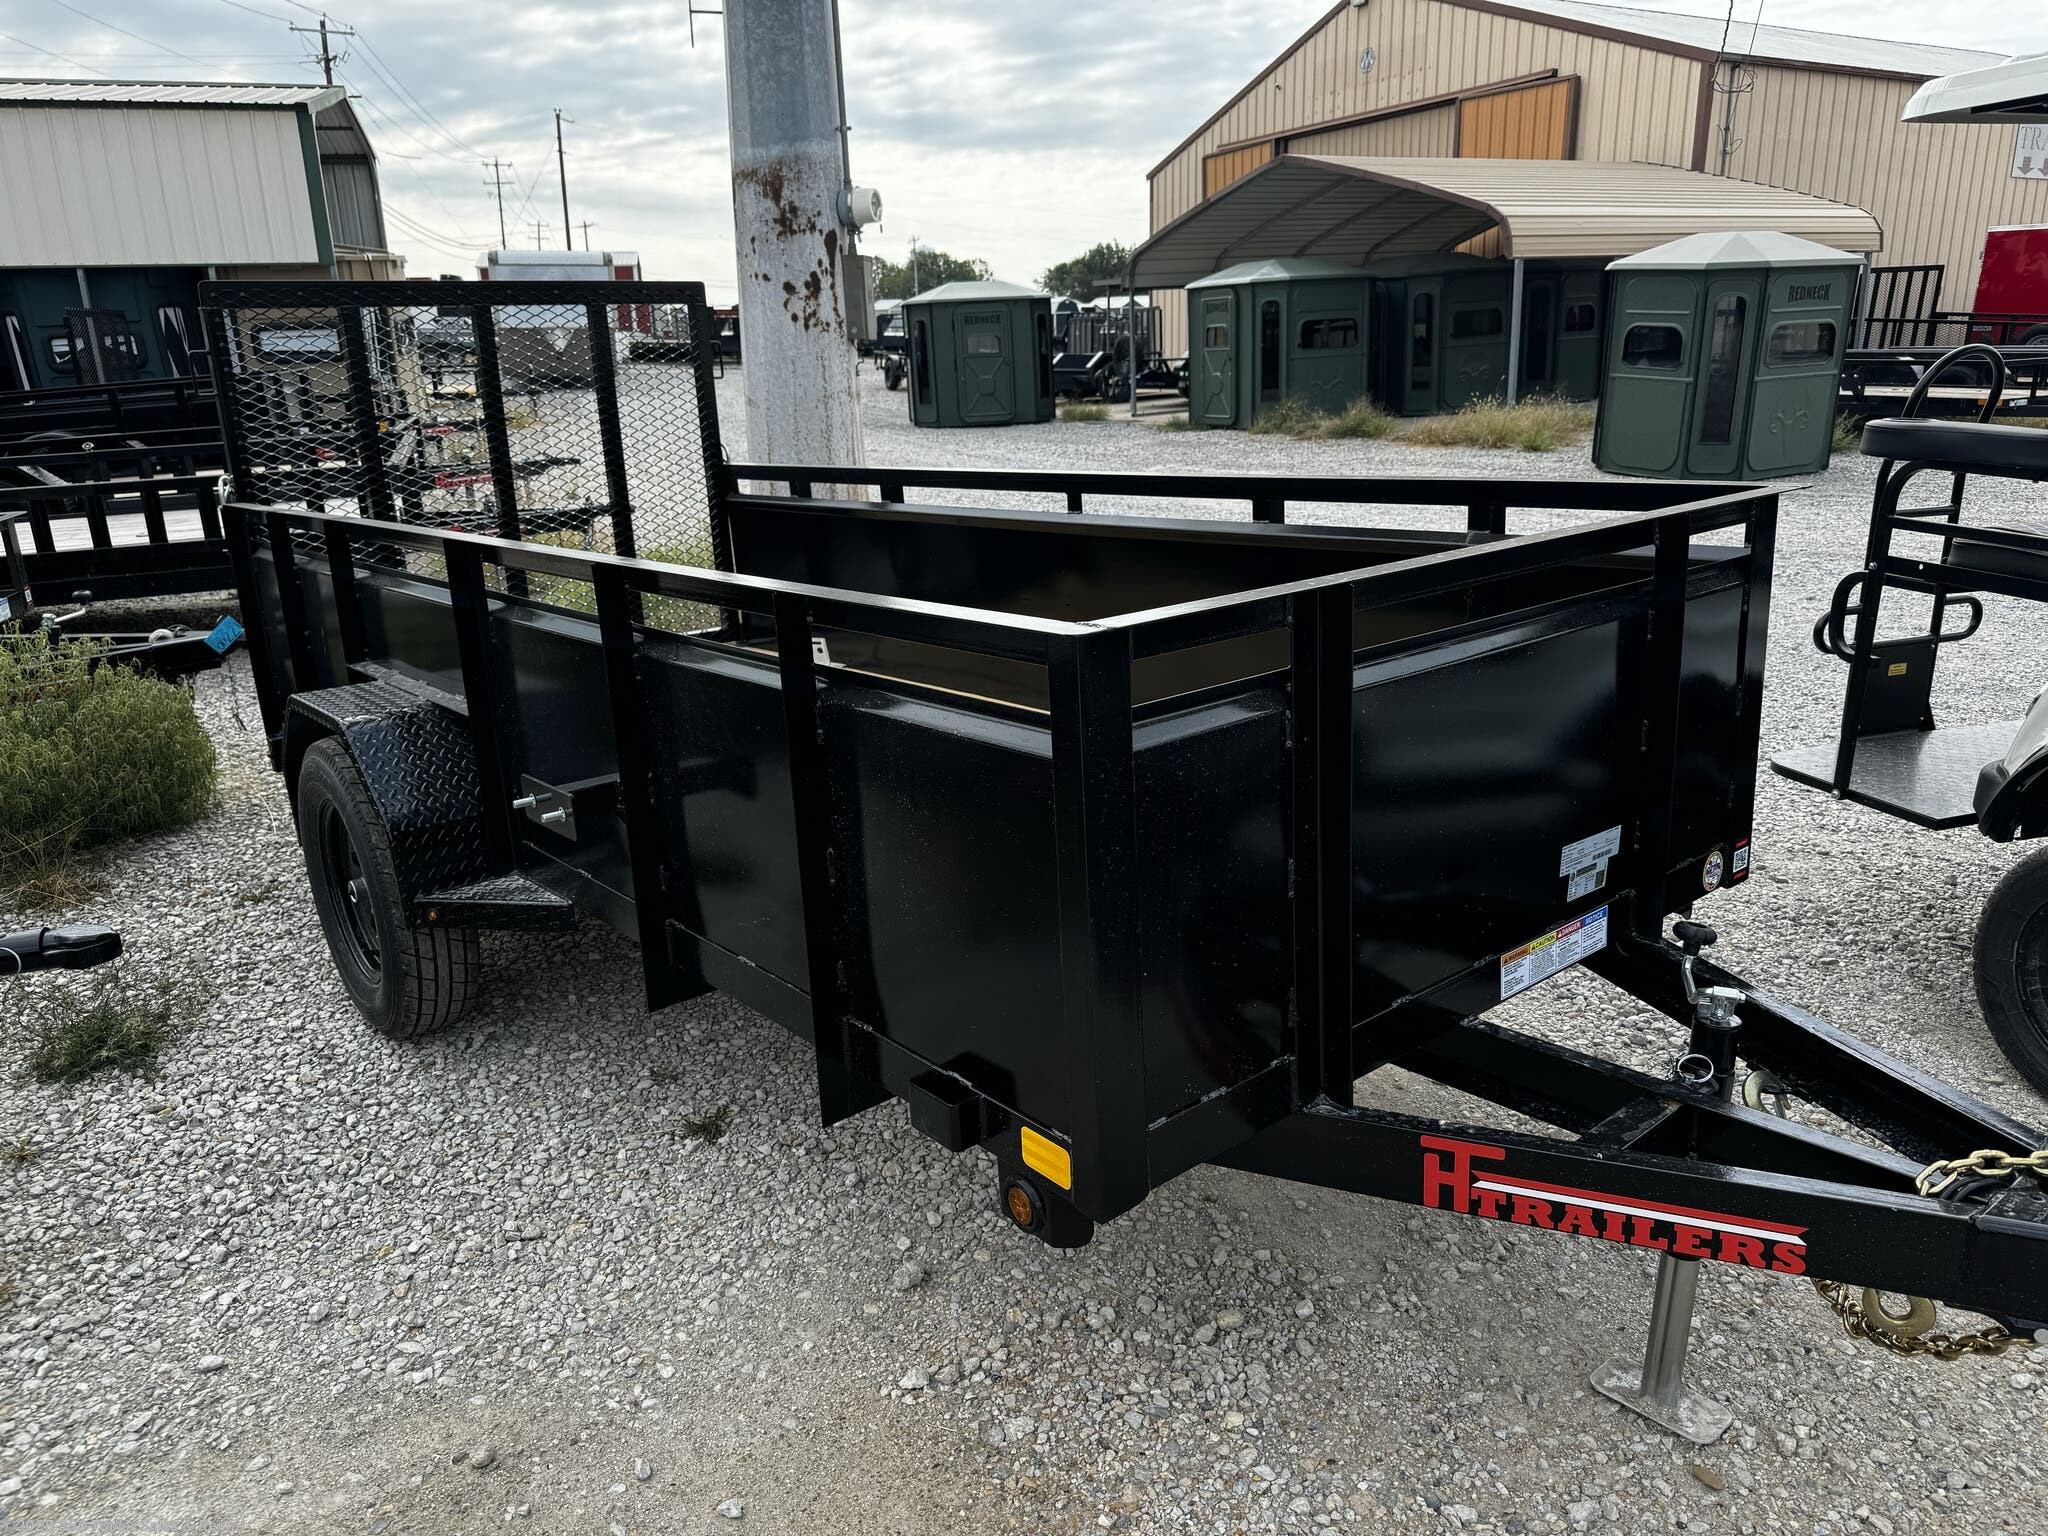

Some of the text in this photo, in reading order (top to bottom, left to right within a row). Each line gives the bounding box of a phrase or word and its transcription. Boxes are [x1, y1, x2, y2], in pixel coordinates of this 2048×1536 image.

[1788, 282, 1831, 303] REDNECK
[1585, 911, 1604, 925] NOTICE
[1561, 921, 1581, 936] DANGER
[1535, 934, 1555, 949] CAUTION
[1470, 1187, 1807, 1275] TRAILERS
